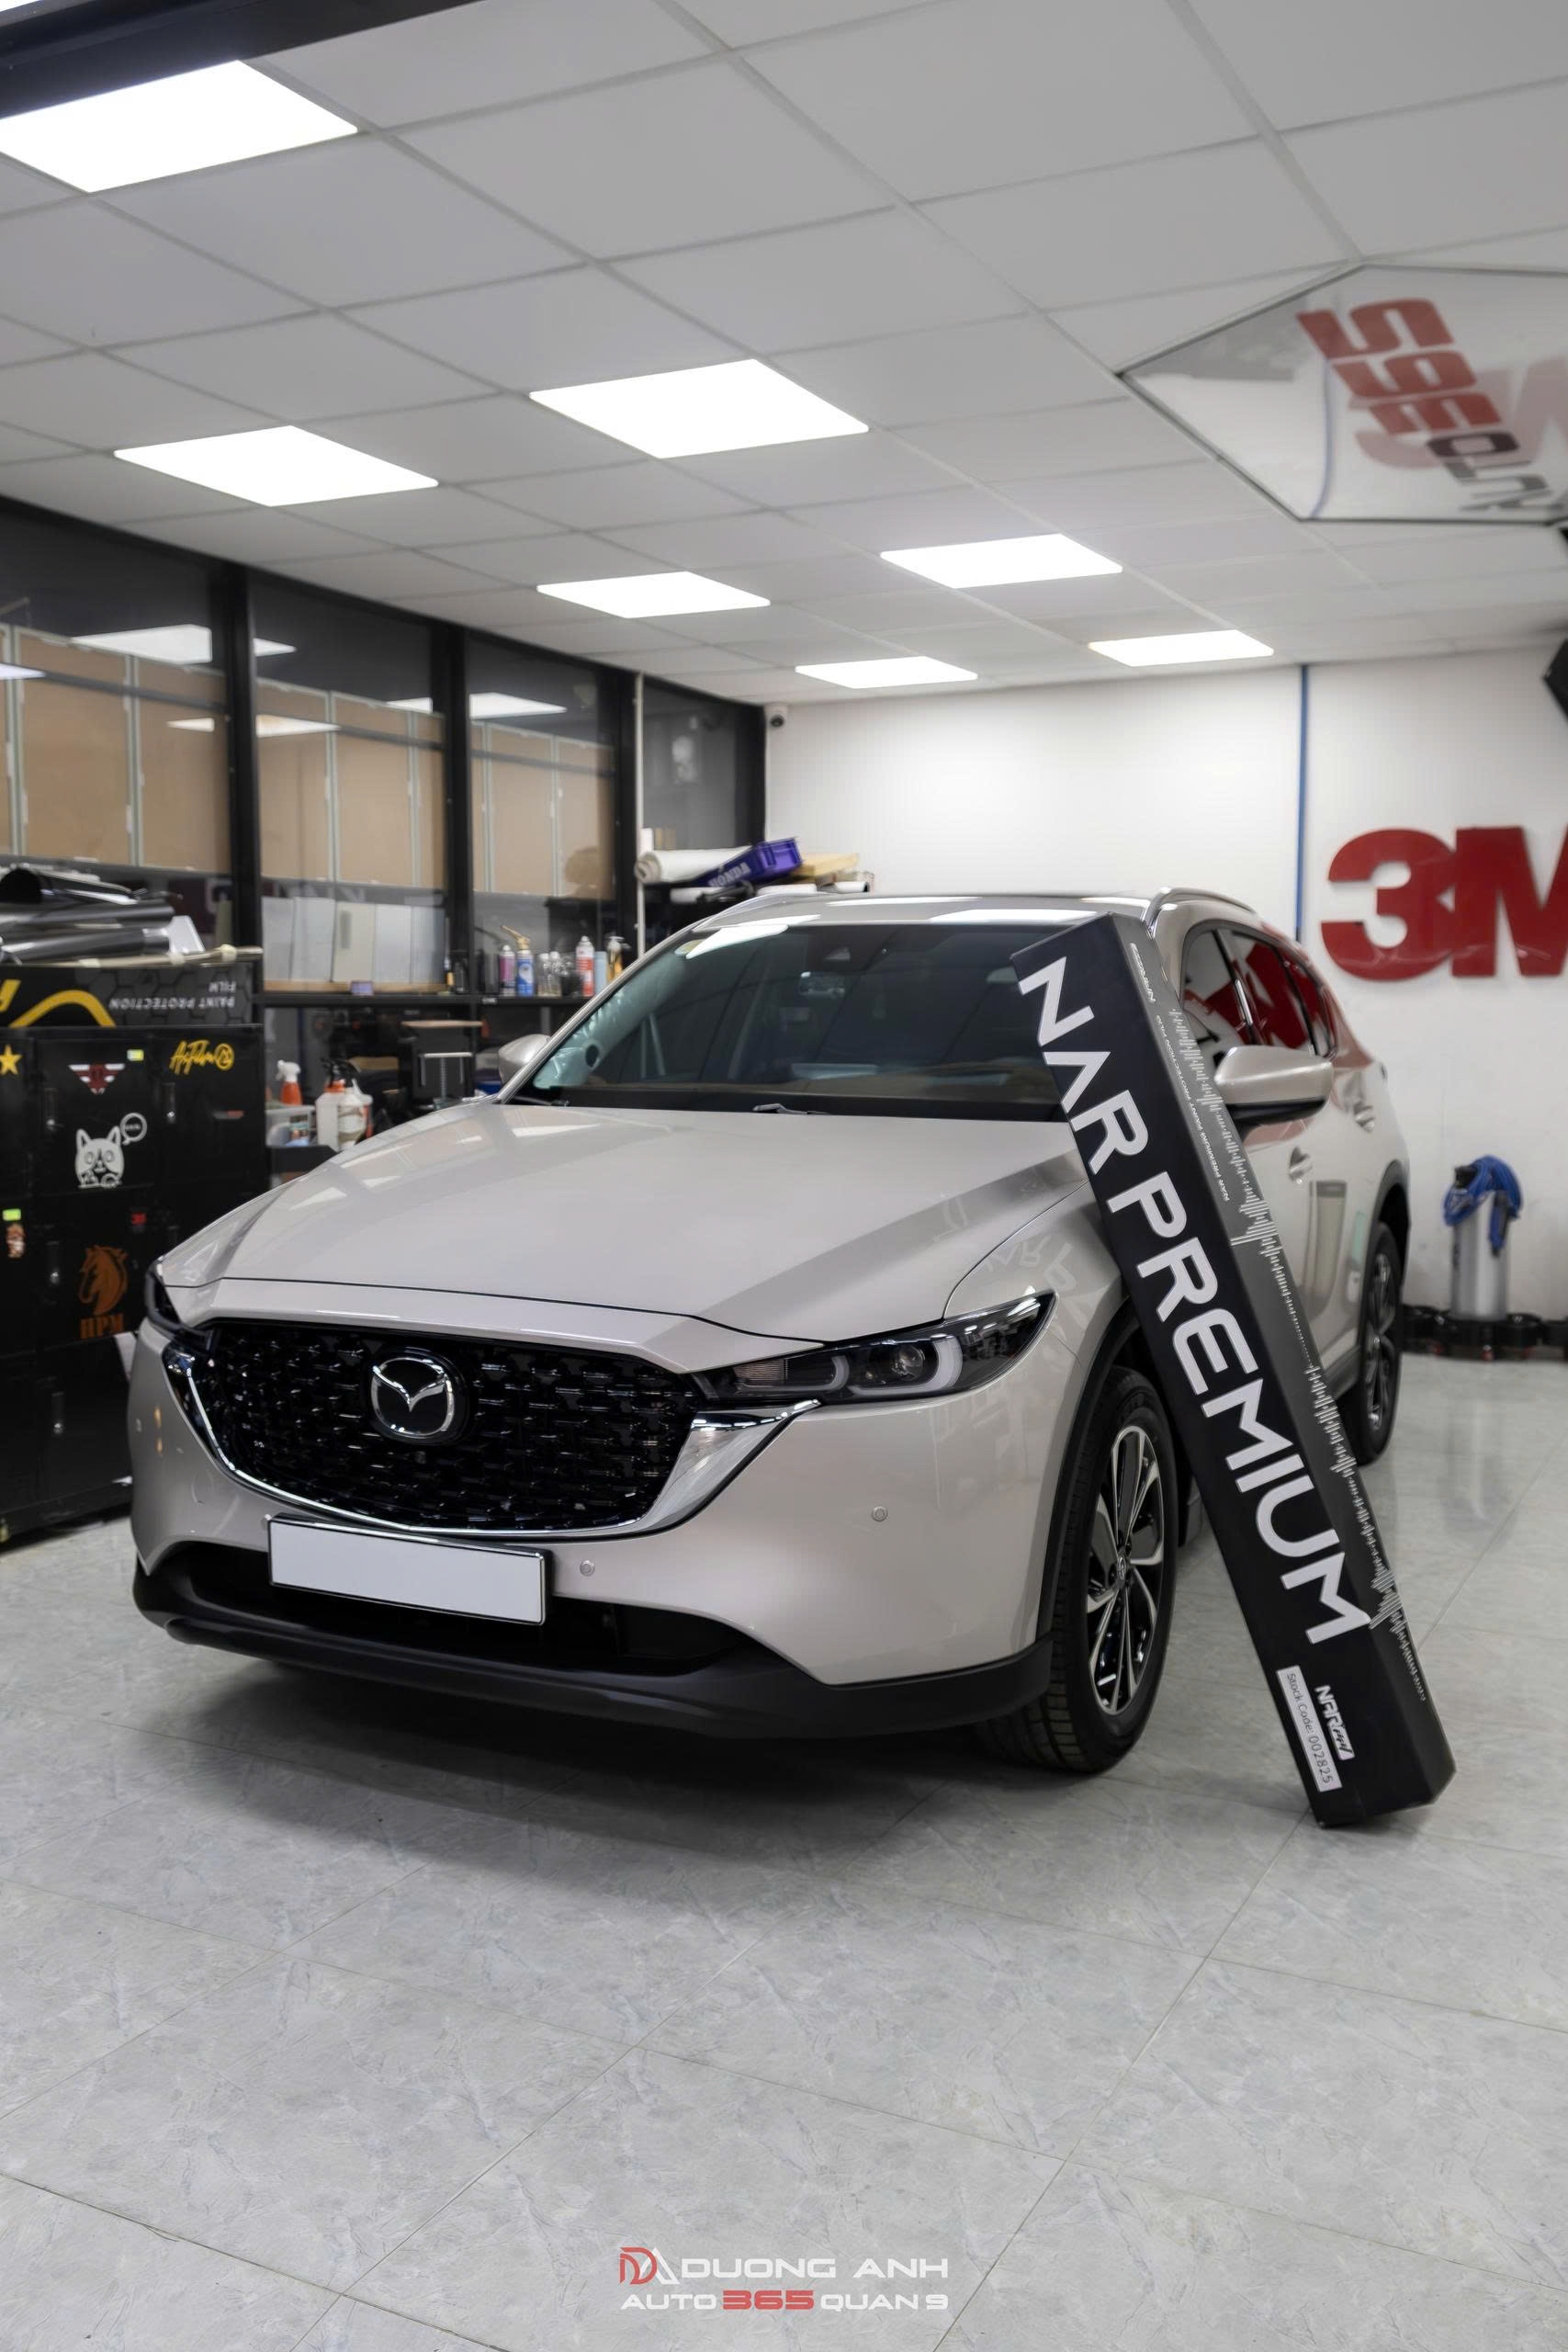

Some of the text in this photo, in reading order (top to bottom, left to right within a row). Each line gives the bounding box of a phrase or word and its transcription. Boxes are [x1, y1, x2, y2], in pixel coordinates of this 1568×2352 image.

[1321, 824, 1568, 982] 3M
[108, 996, 236, 1010] PAINT PROTECTION
[209, 980, 237, 993] FILM
[1018, 956, 1150, 1175] NAR
[1107, 1170, 1372, 1645] PREMIUM
[1308, 1736, 1333, 1783] 002825
